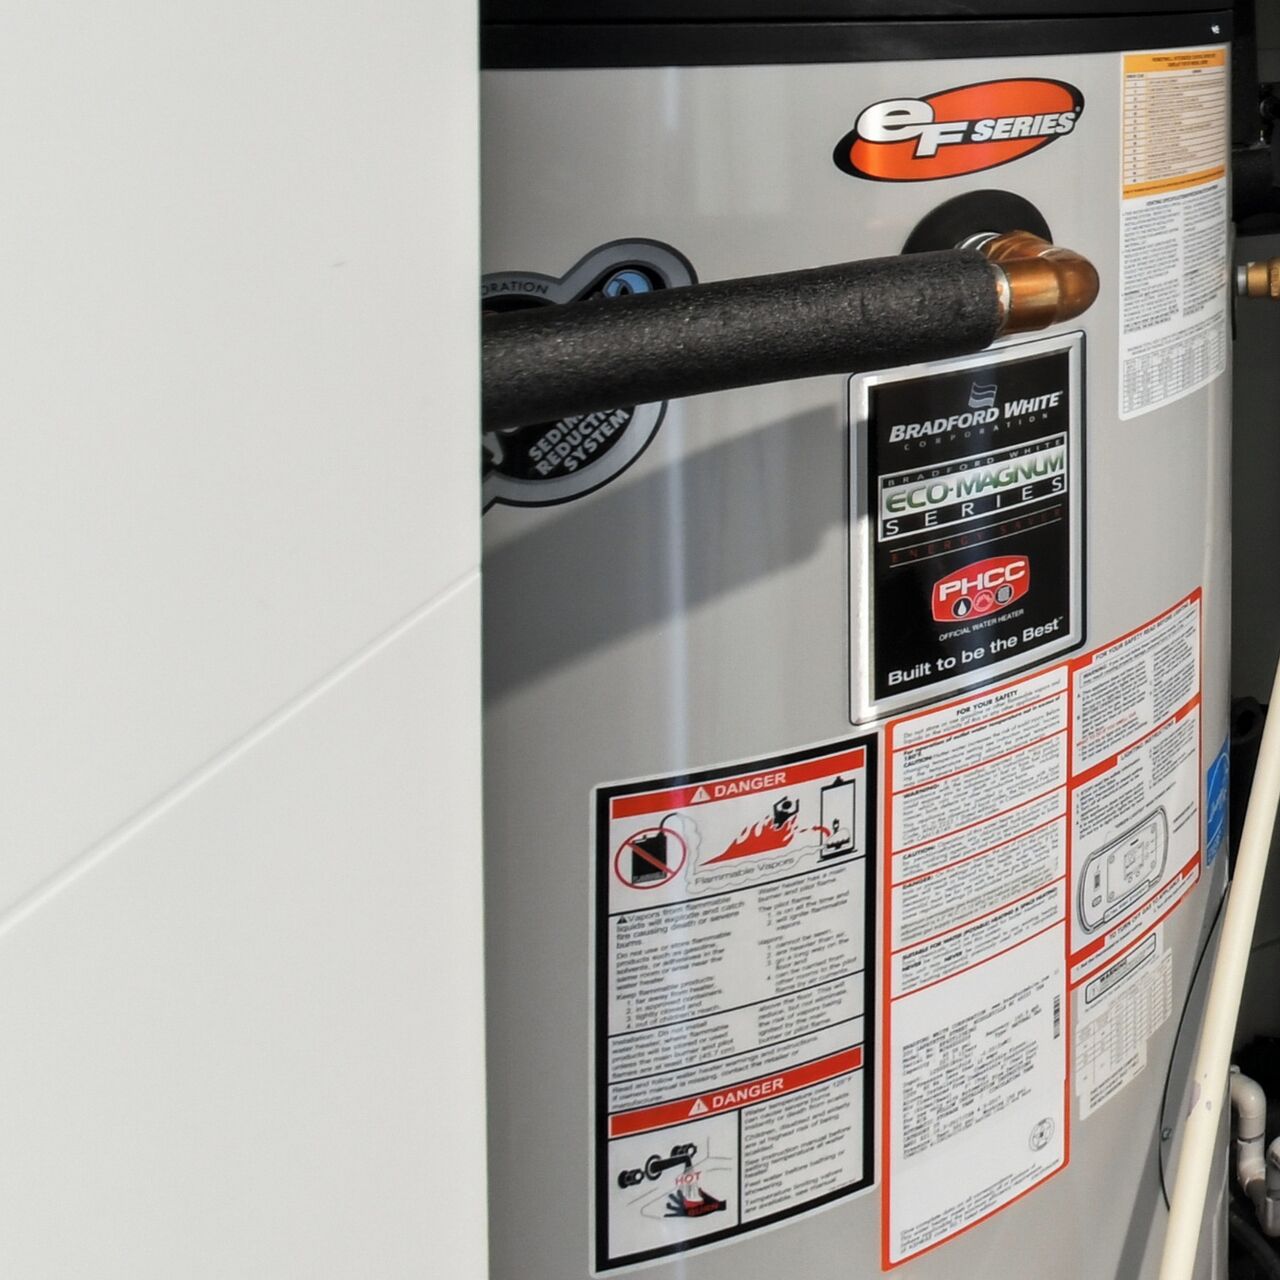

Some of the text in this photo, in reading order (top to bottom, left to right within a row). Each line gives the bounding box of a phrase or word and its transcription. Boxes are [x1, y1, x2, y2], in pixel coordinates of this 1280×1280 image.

[970, 111, 1076, 142] SERIES
[888, 390, 1060, 444] BRADFORD WHITE
[902, 412, 1048, 453] CORPORATION
[563, 408, 631, 472] SYSTEM
[1008, 437, 1062, 459] WHITE
[884, 475, 1063, 537] SERIES
[938, 559, 1026, 602] PHCC
[937, 607, 1024, 642] OFFICIAL WATER HEATER
[887, 616, 1059, 689] Built to be the Best
[955, 688, 1018, 717] FOR YOUR SAFETY
[714, 772, 786, 798] DANGER
[757, 855, 795, 872] Vapors
[616, 921, 645, 934] liquids
[701, 906, 719, 915] and
[720, 901, 745, 911] catch
[626, 896, 731, 923] Vapors from flammable
[616, 931, 631, 941] fire
[632, 925, 668, 939] causing
[670, 919, 696, 930] death
[709, 911, 739, 921] severe
[616, 950, 628, 959] Do
[629, 949, 642, 957] not
[712, 1077, 785, 1109] DANGER
[675, 1171, 702, 1186] HOT
